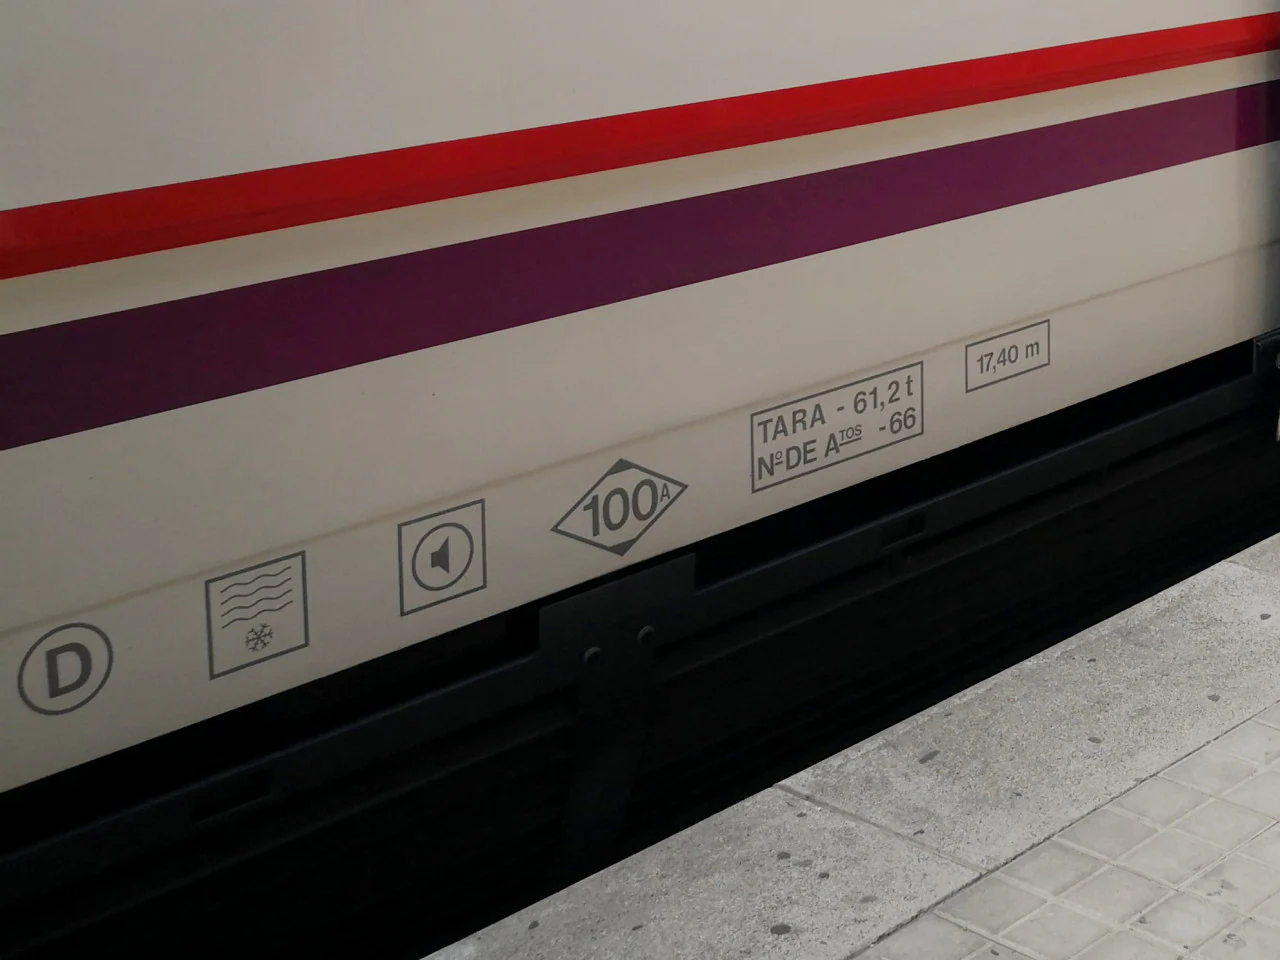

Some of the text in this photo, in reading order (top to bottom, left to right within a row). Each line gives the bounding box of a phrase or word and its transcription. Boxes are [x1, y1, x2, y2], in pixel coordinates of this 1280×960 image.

[976, 339, 1041, 375] 17,40 m
[757, 402, 826, 444] TARA
[853, 380, 900, 413] 61,2
[905, 374, 914, 397] t
[46, 642, 92, 699] D
